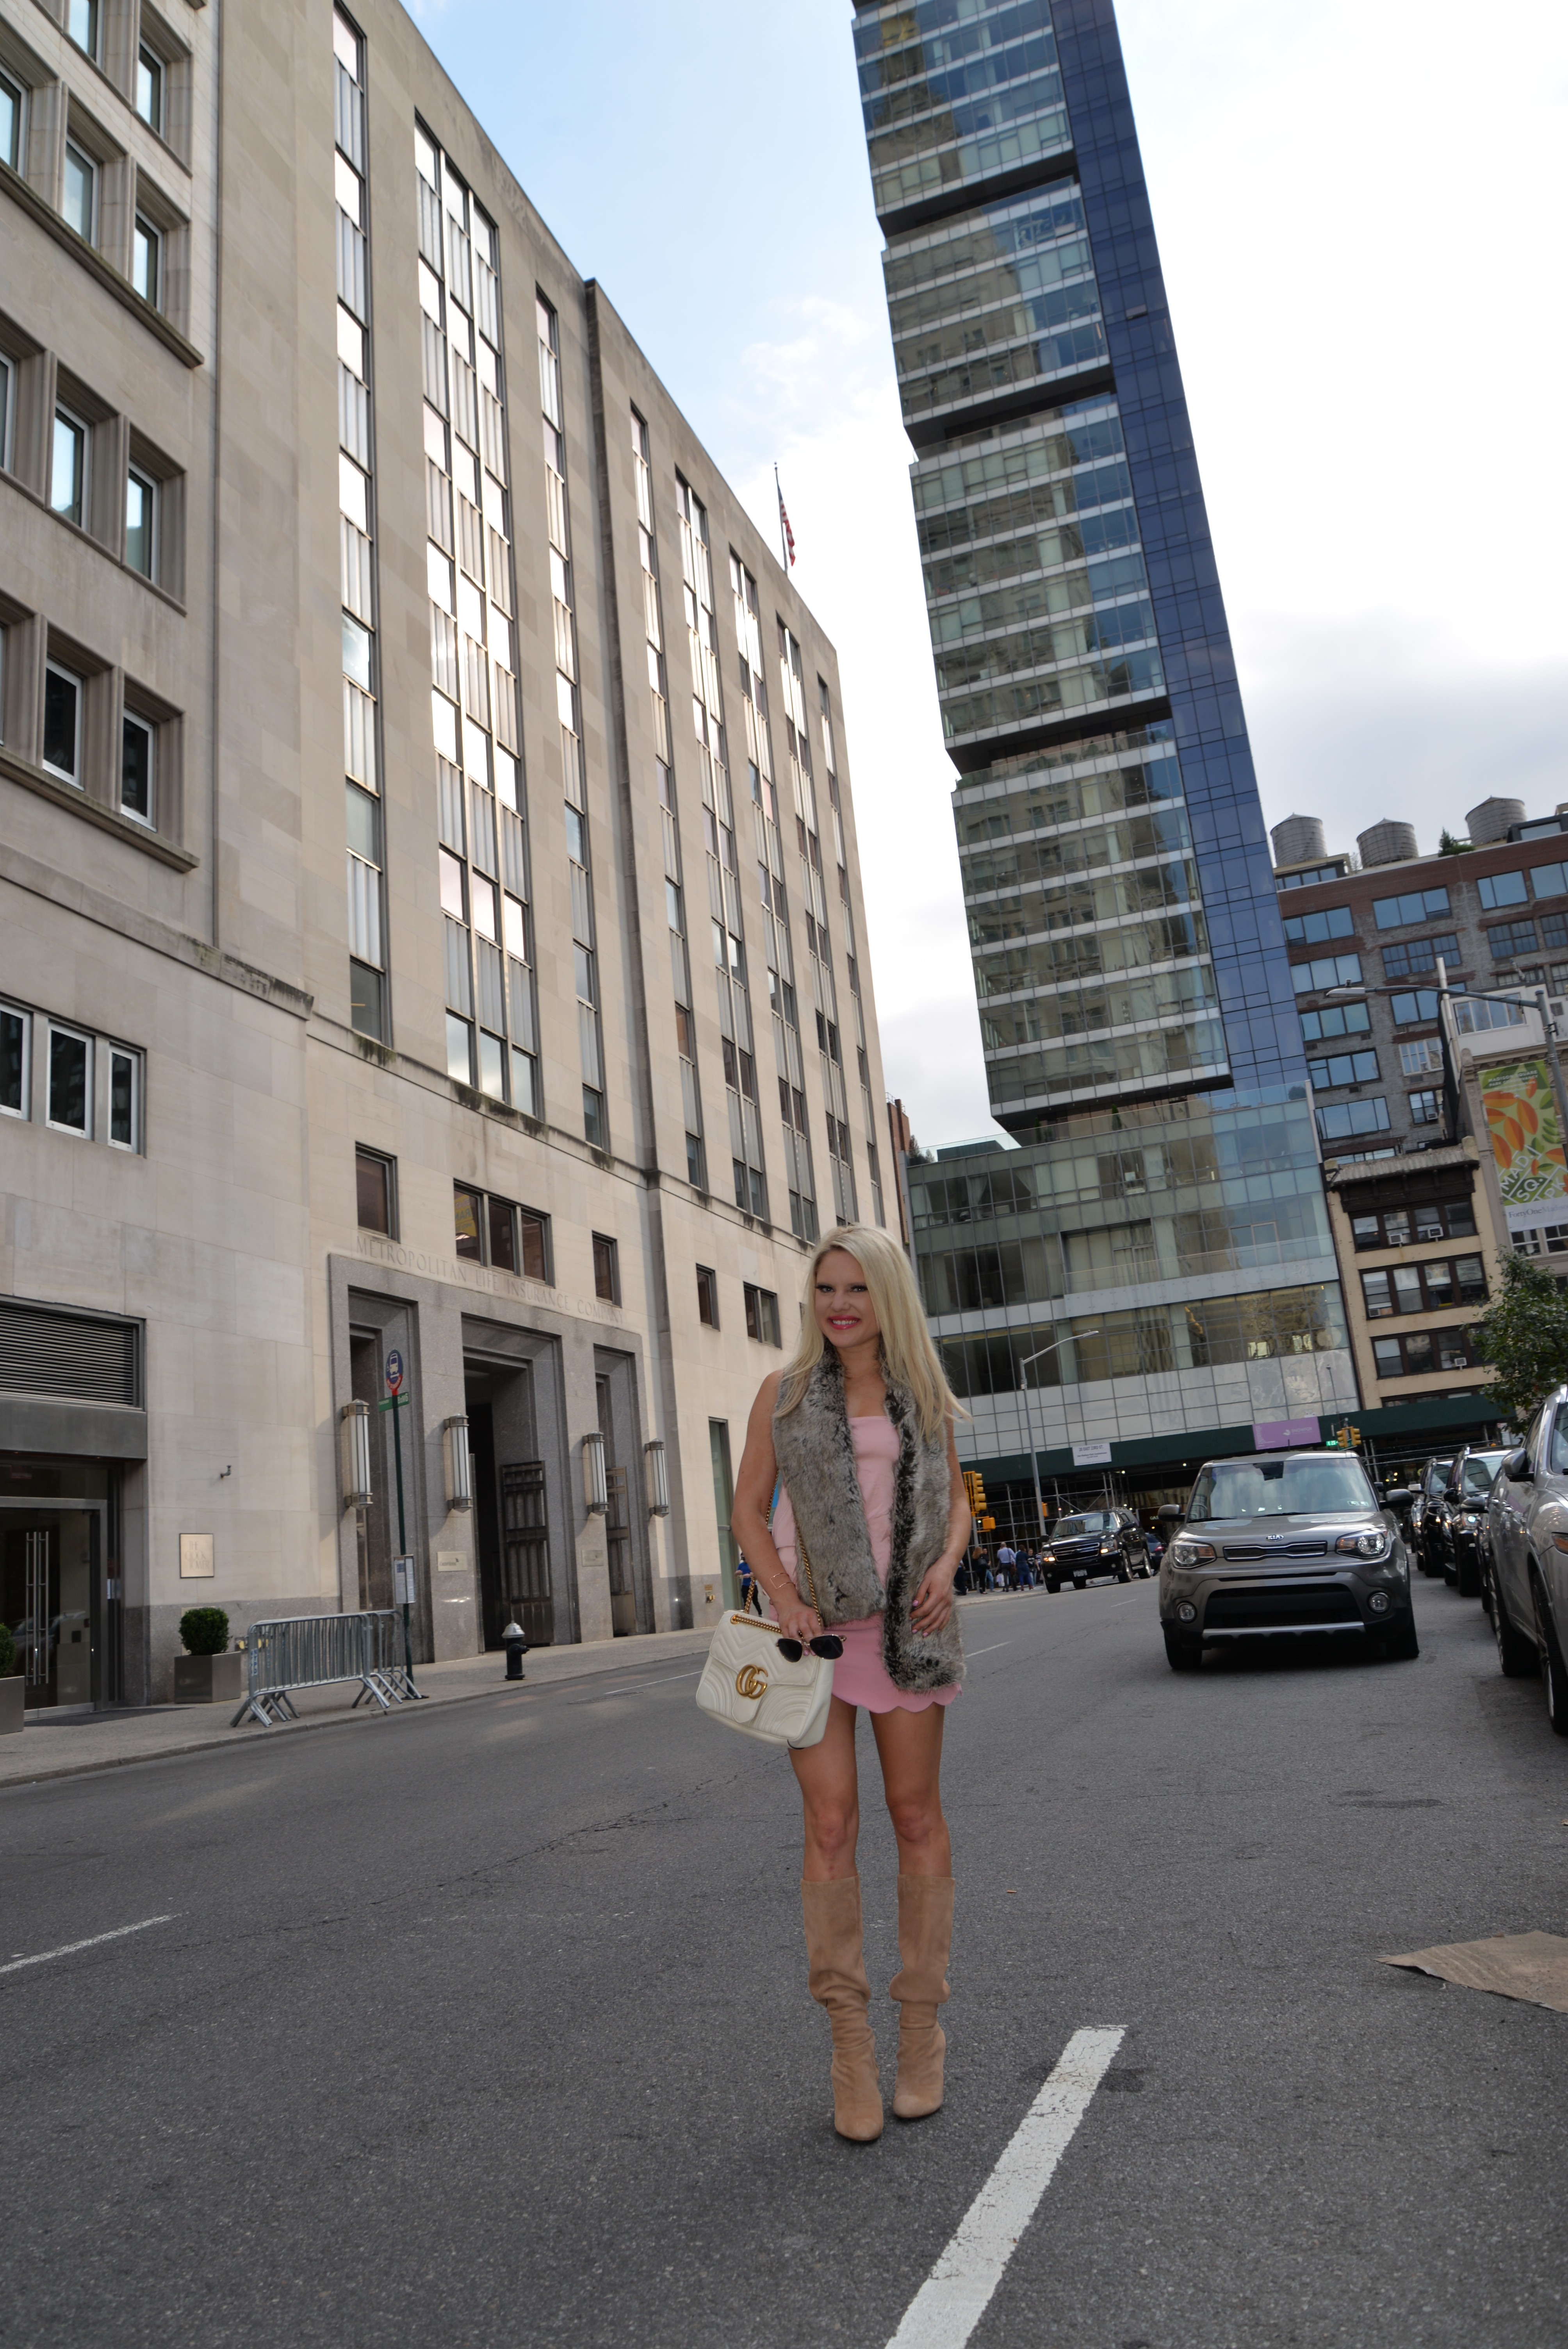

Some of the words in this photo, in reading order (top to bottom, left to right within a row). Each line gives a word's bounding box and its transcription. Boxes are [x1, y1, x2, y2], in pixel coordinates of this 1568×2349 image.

[356, 1236, 466, 1282] METROPOLITAN
[476, 1270, 499, 1291] LIFE
[508, 1279, 570, 1311] INSURANCE
[577, 1299, 624, 1325] COMPANY
[188, 1541, 198, 1551] THE
